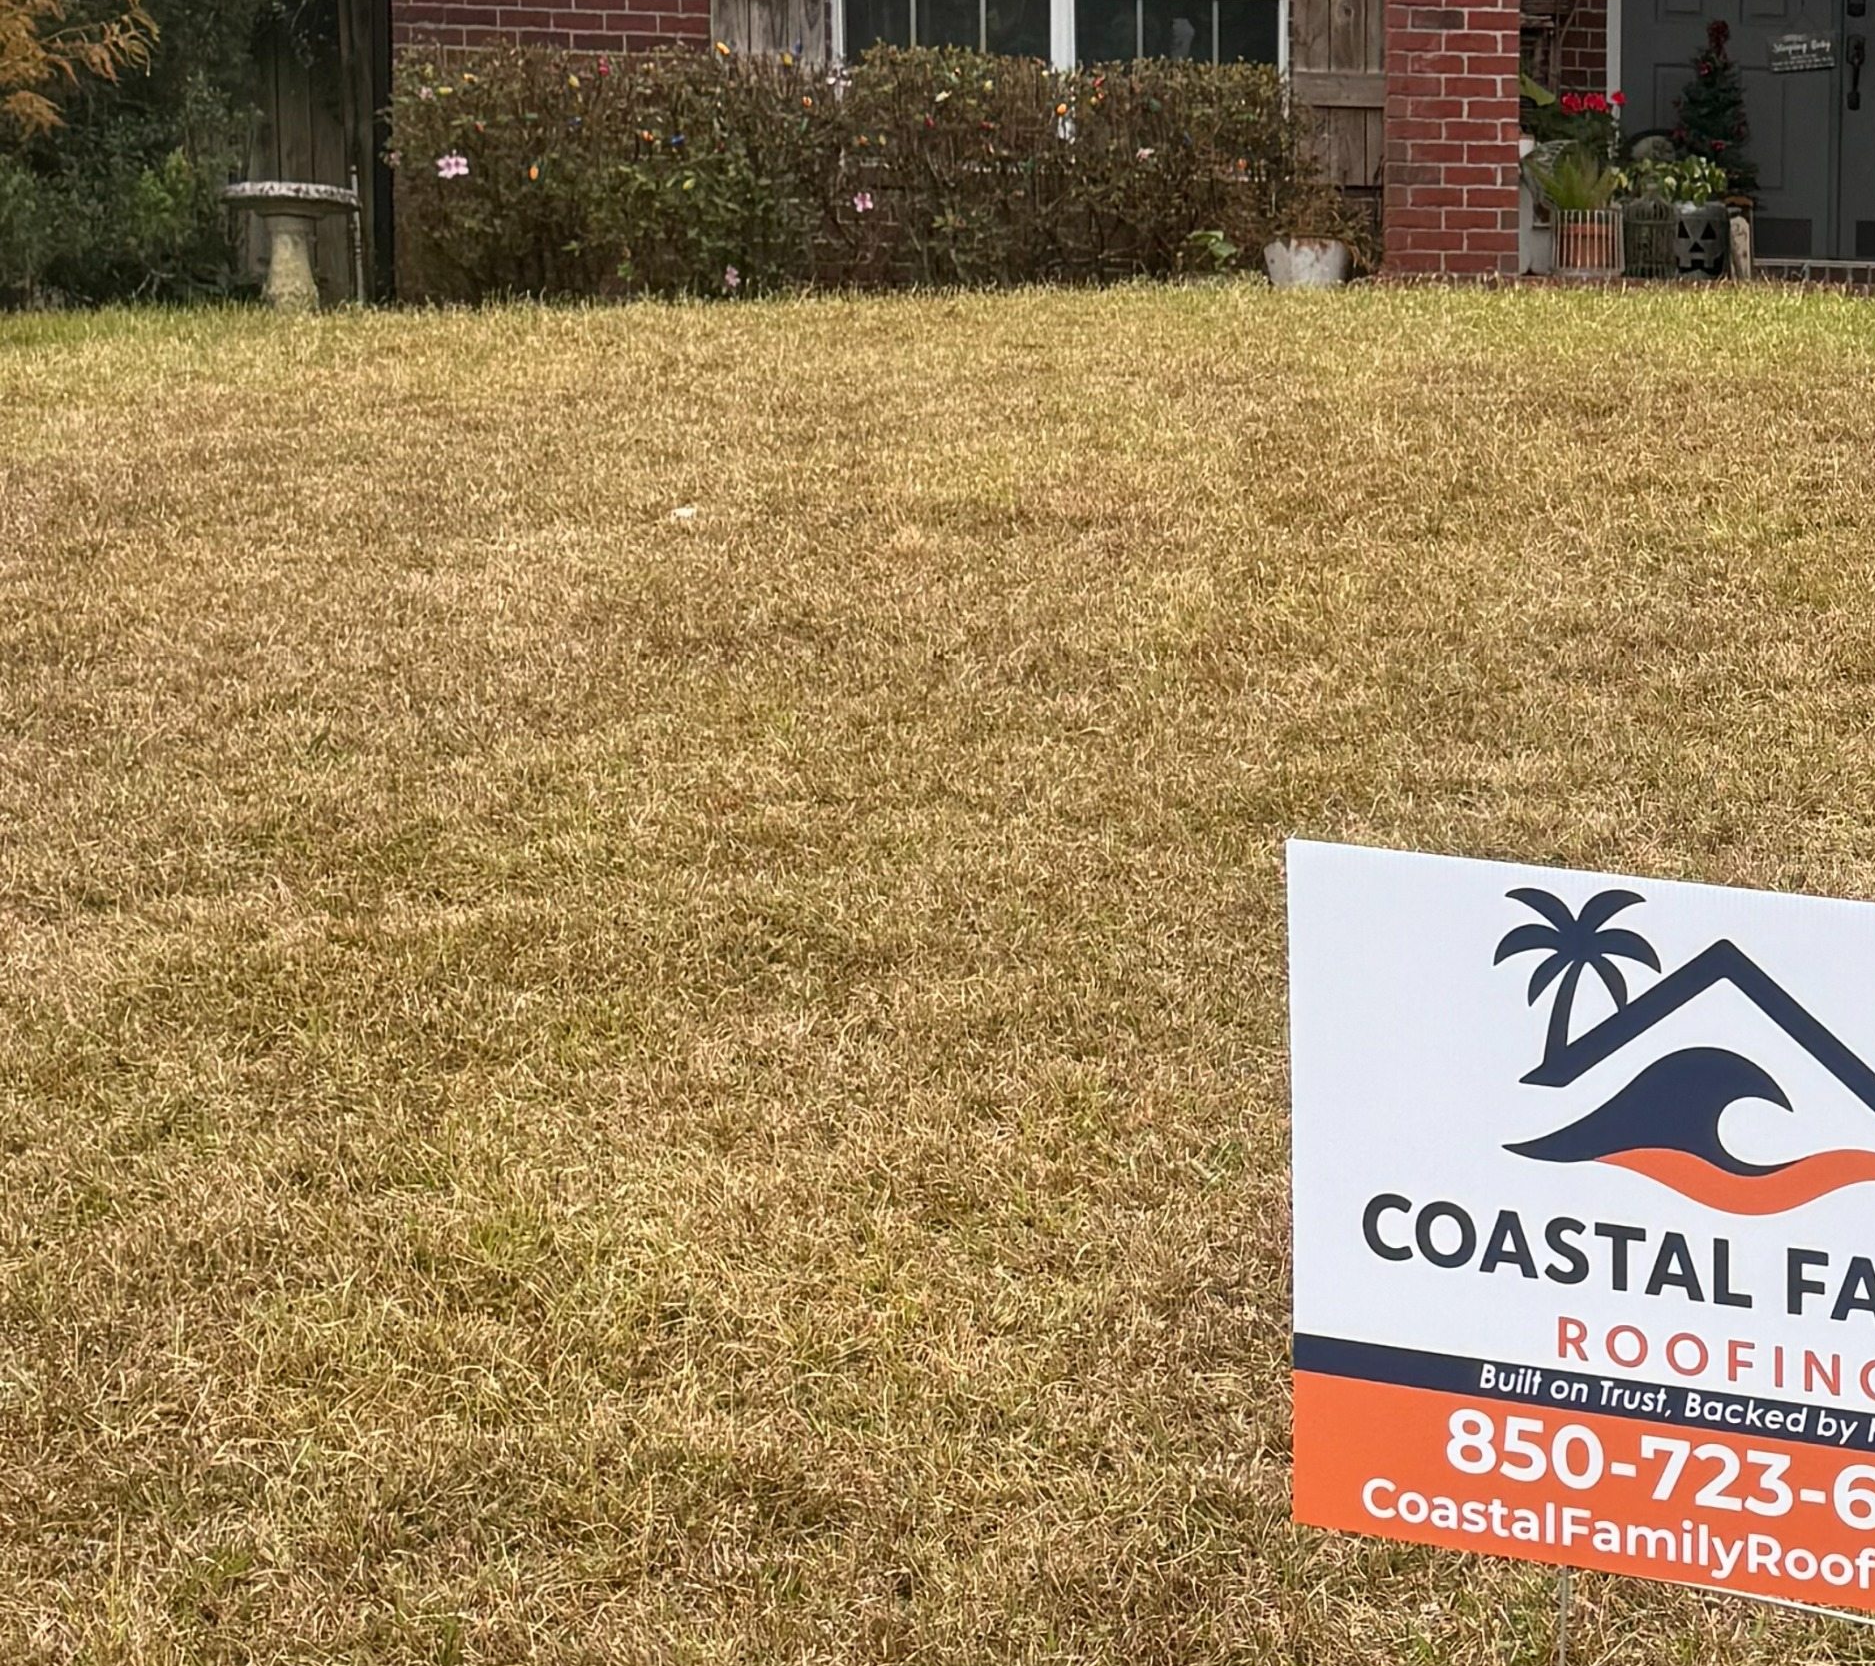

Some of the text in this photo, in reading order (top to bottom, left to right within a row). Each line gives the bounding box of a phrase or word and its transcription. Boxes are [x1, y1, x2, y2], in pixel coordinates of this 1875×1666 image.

[1362, 1193, 1752, 1308] COASTAL
[1479, 1363, 1542, 1396] Built
[1549, 1379, 1589, 1404] on
[1599, 1380, 1671, 1418] Trust,
[1684, 1391, 1808, 1433] Backed
[1816, 1409, 1858, 1445] by
